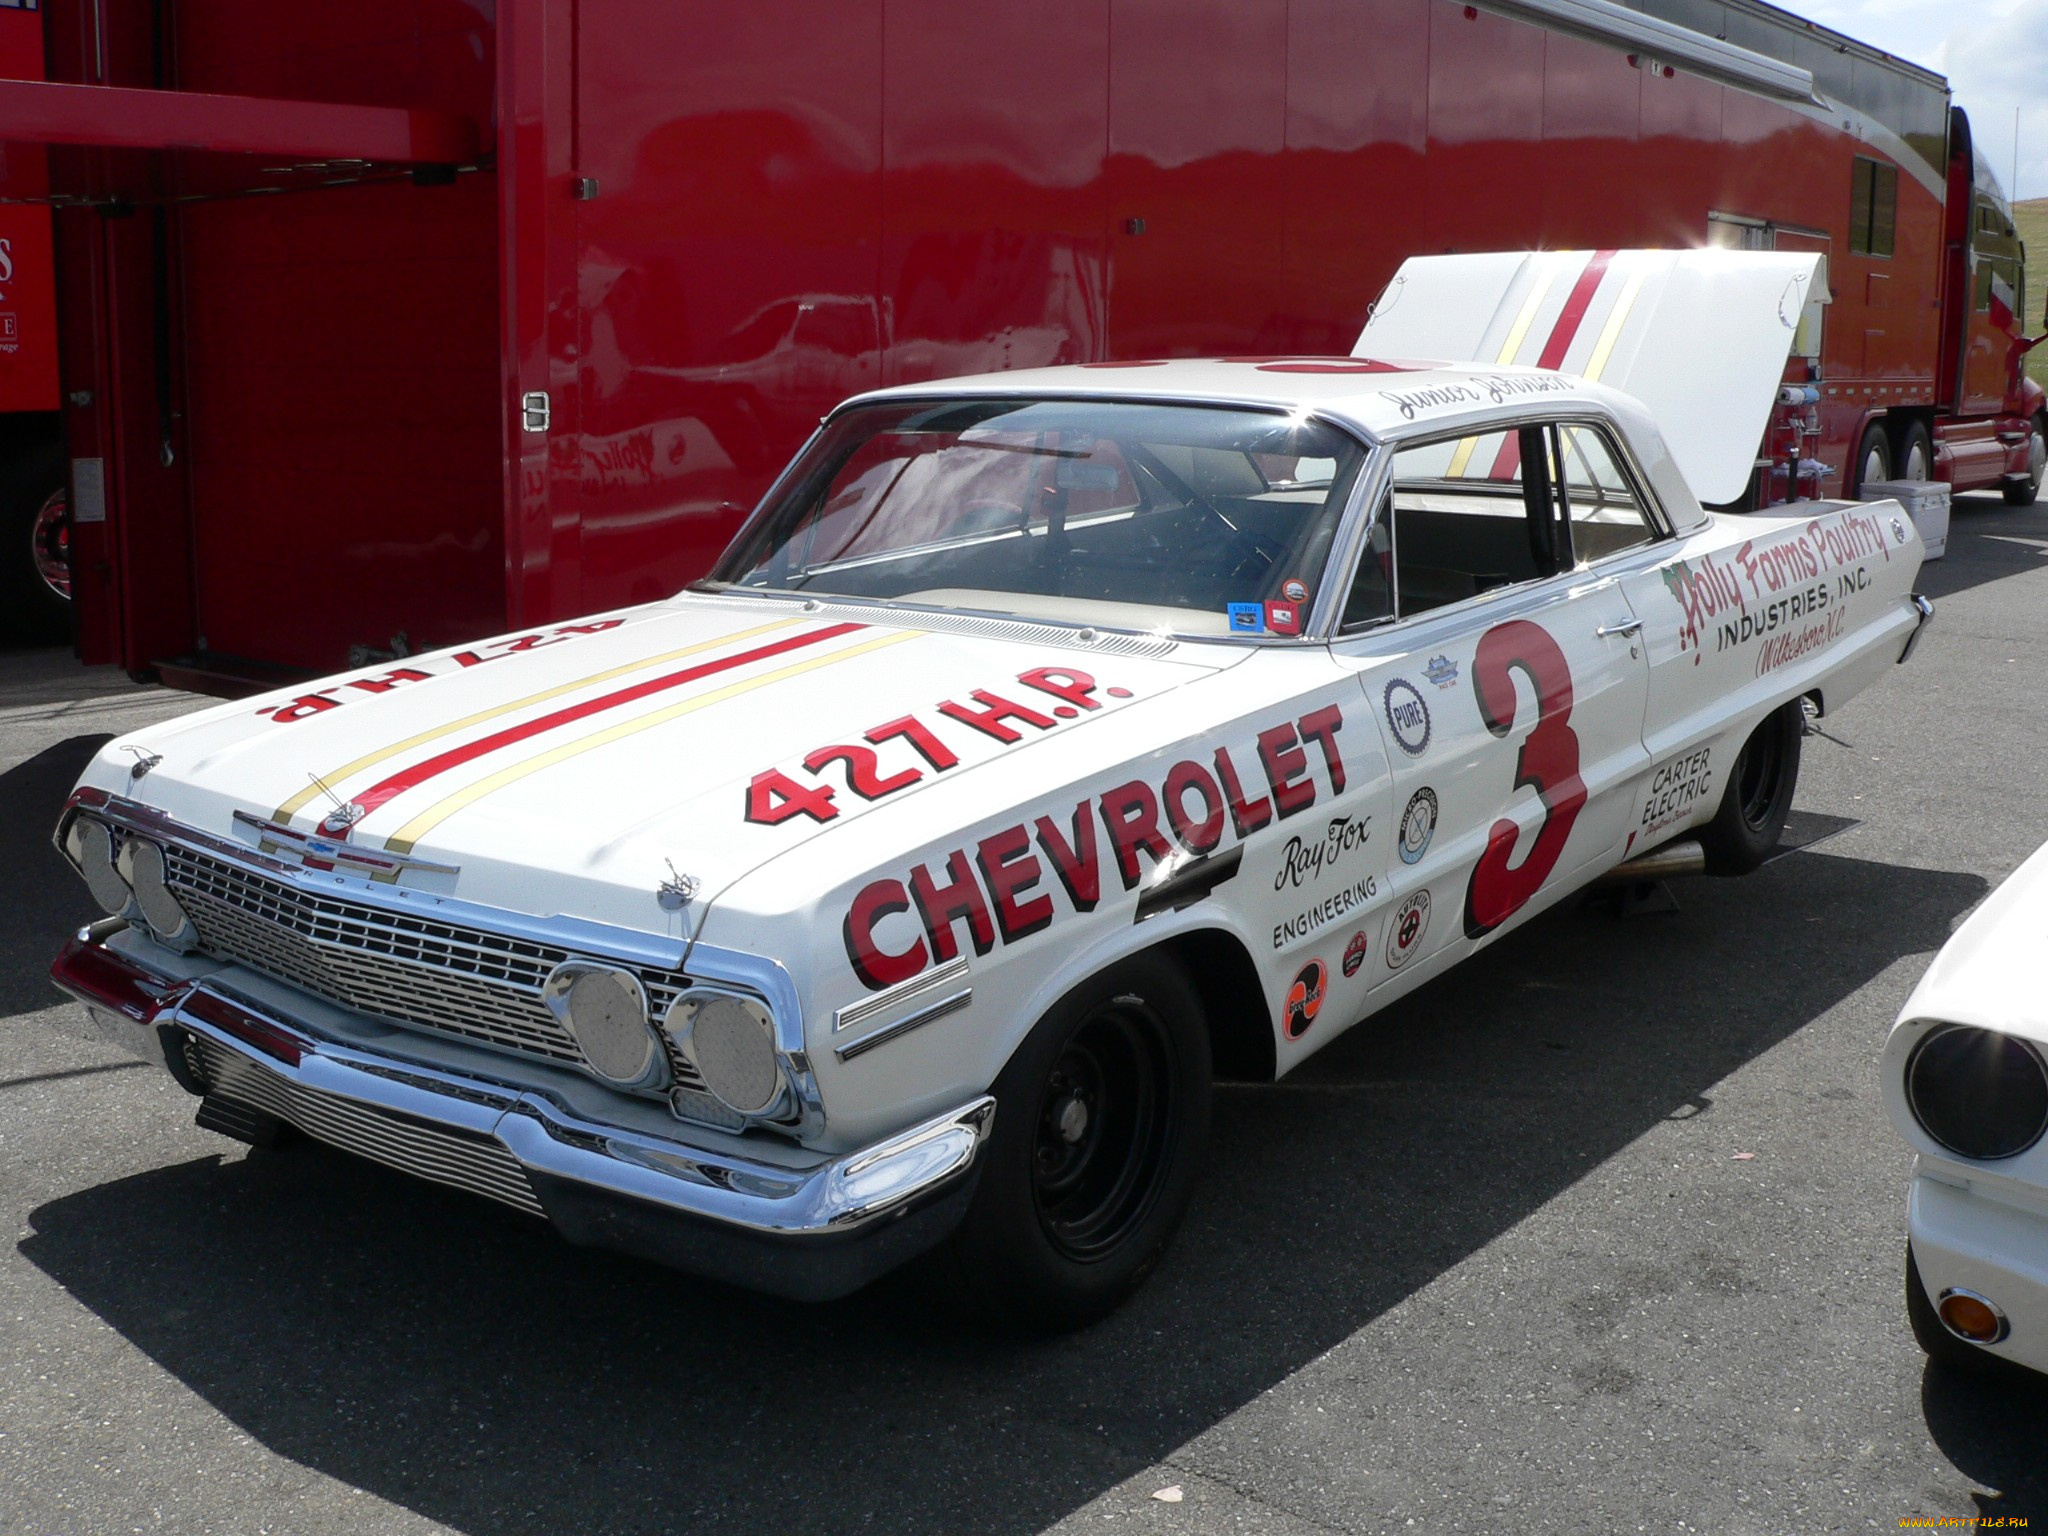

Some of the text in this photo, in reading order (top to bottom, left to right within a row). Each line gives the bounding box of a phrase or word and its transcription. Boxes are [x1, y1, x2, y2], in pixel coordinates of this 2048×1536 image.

[1379, 375, 1575, 419] Junior Johnson
[1671, 512, 1890, 648] Holly Farms Poultry
[1717, 567, 1872, 652] INDUSTRIES, INC.
[744, 666, 1134, 826] 427 H.P.
[1393, 701, 1424, 731] PURE
[1463, 620, 1588, 940] 3
[1642, 770, 1712, 825] ELECTRIC
[1652, 747, 1711, 794] CARTER
[843, 703, 1344, 991] CHEVROLET
[1275, 813, 1372, 891] Ray Fox
[1273, 875, 1377, 949] ENGINEERING
